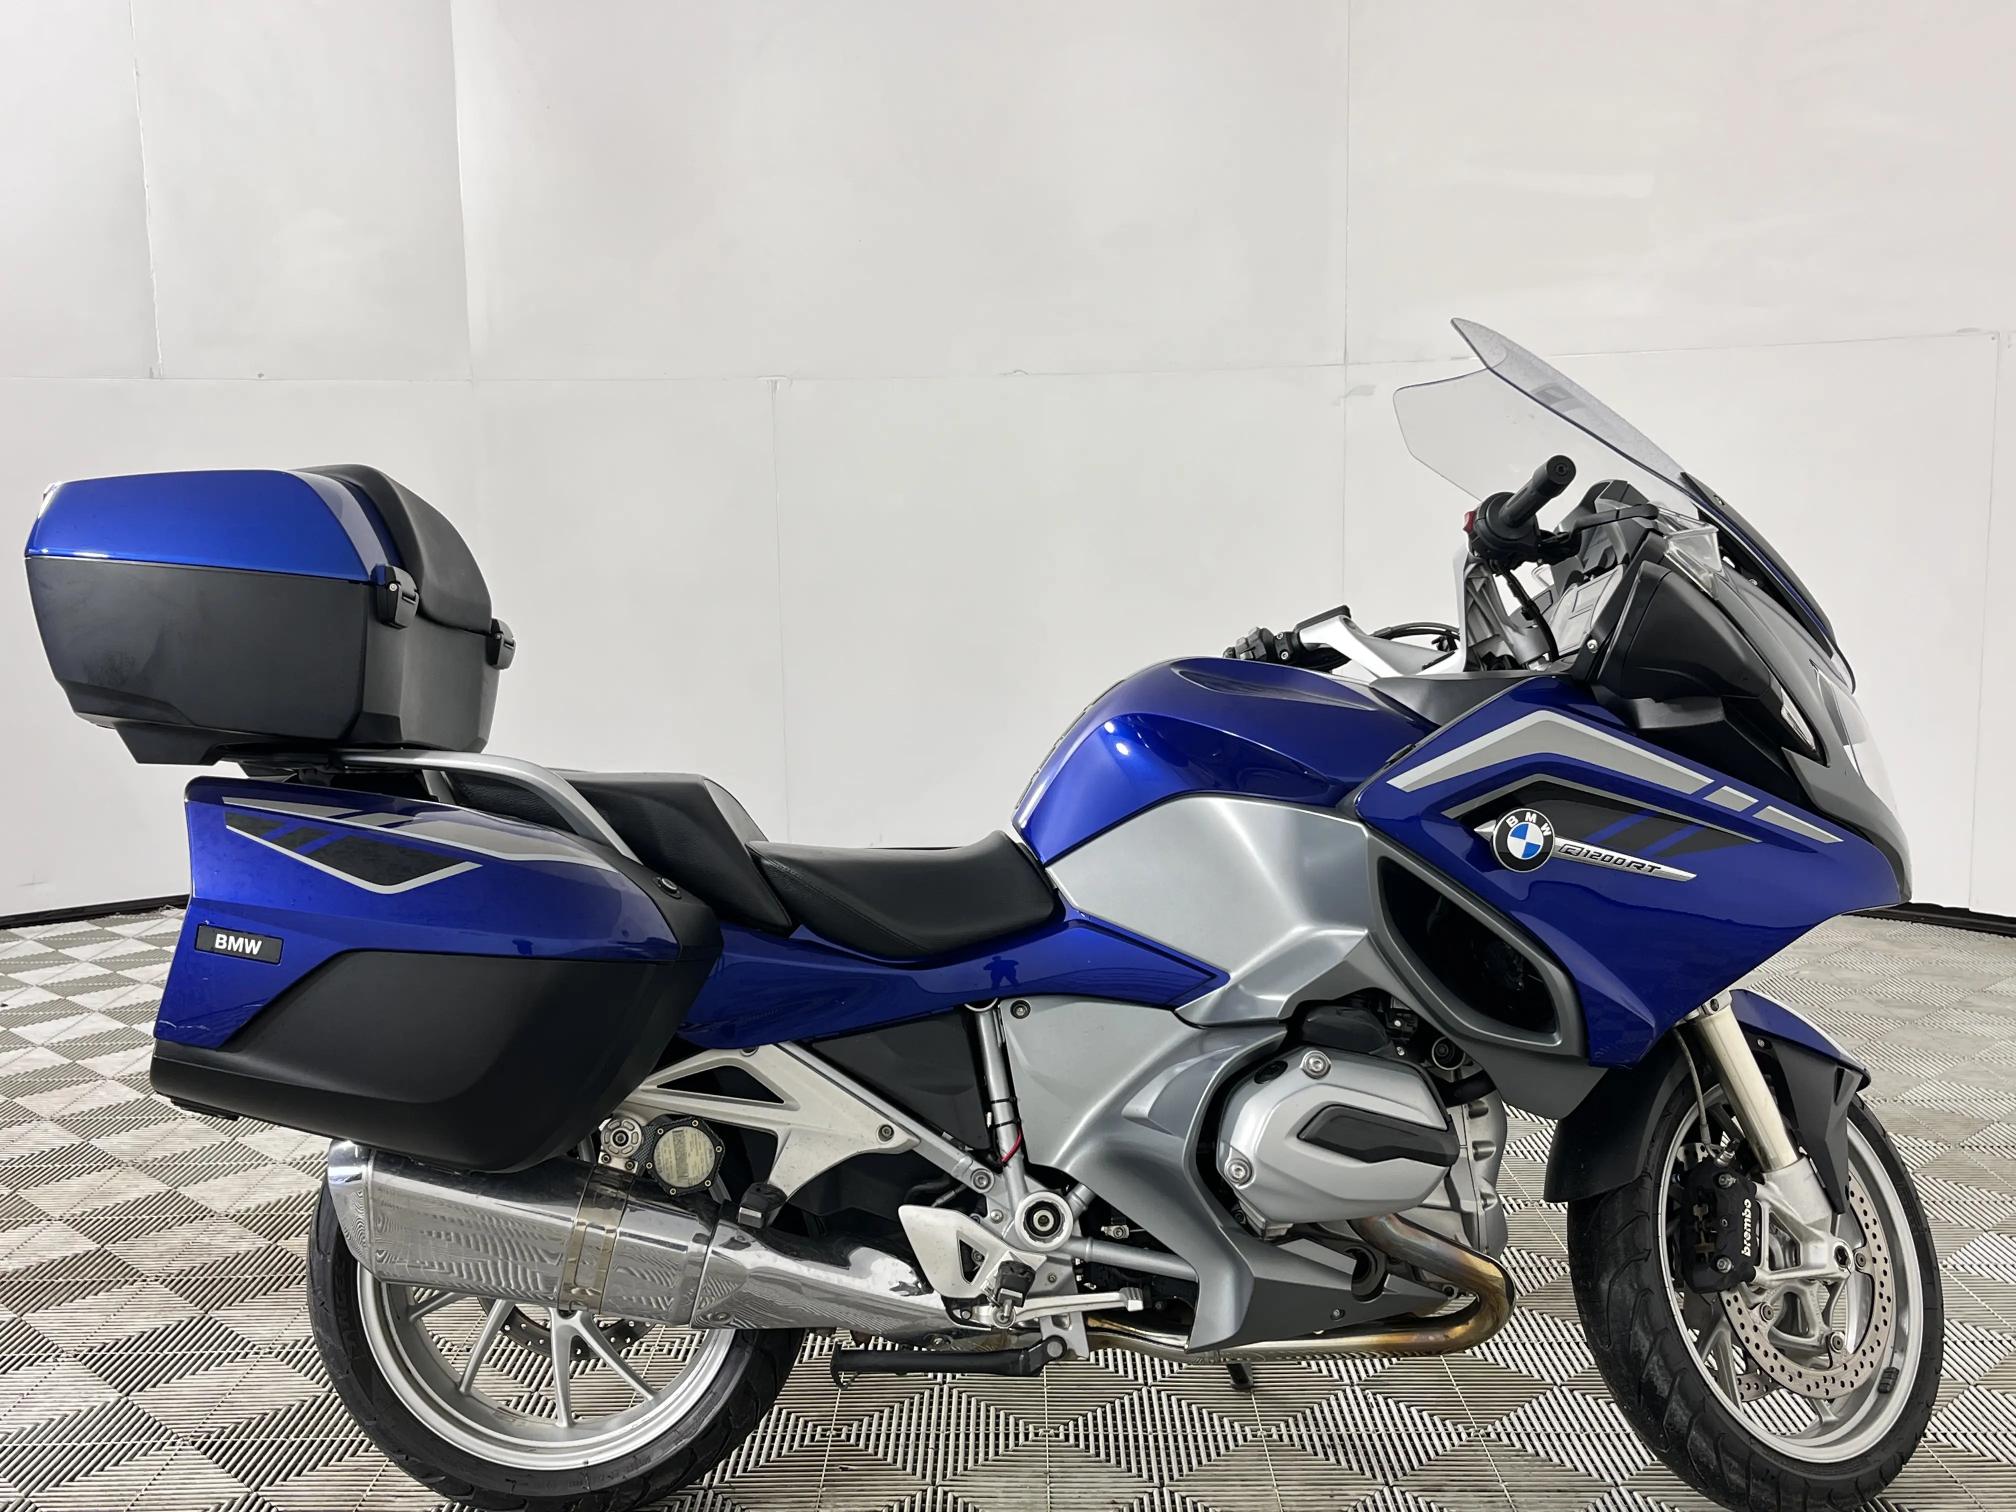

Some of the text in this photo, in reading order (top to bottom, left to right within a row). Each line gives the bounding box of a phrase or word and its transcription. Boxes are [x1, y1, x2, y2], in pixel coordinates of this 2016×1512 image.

[1506, 812, 1552, 836] BMW
[215, 933, 262, 955] BMW
[1742, 1198, 1752, 1257] brembo
